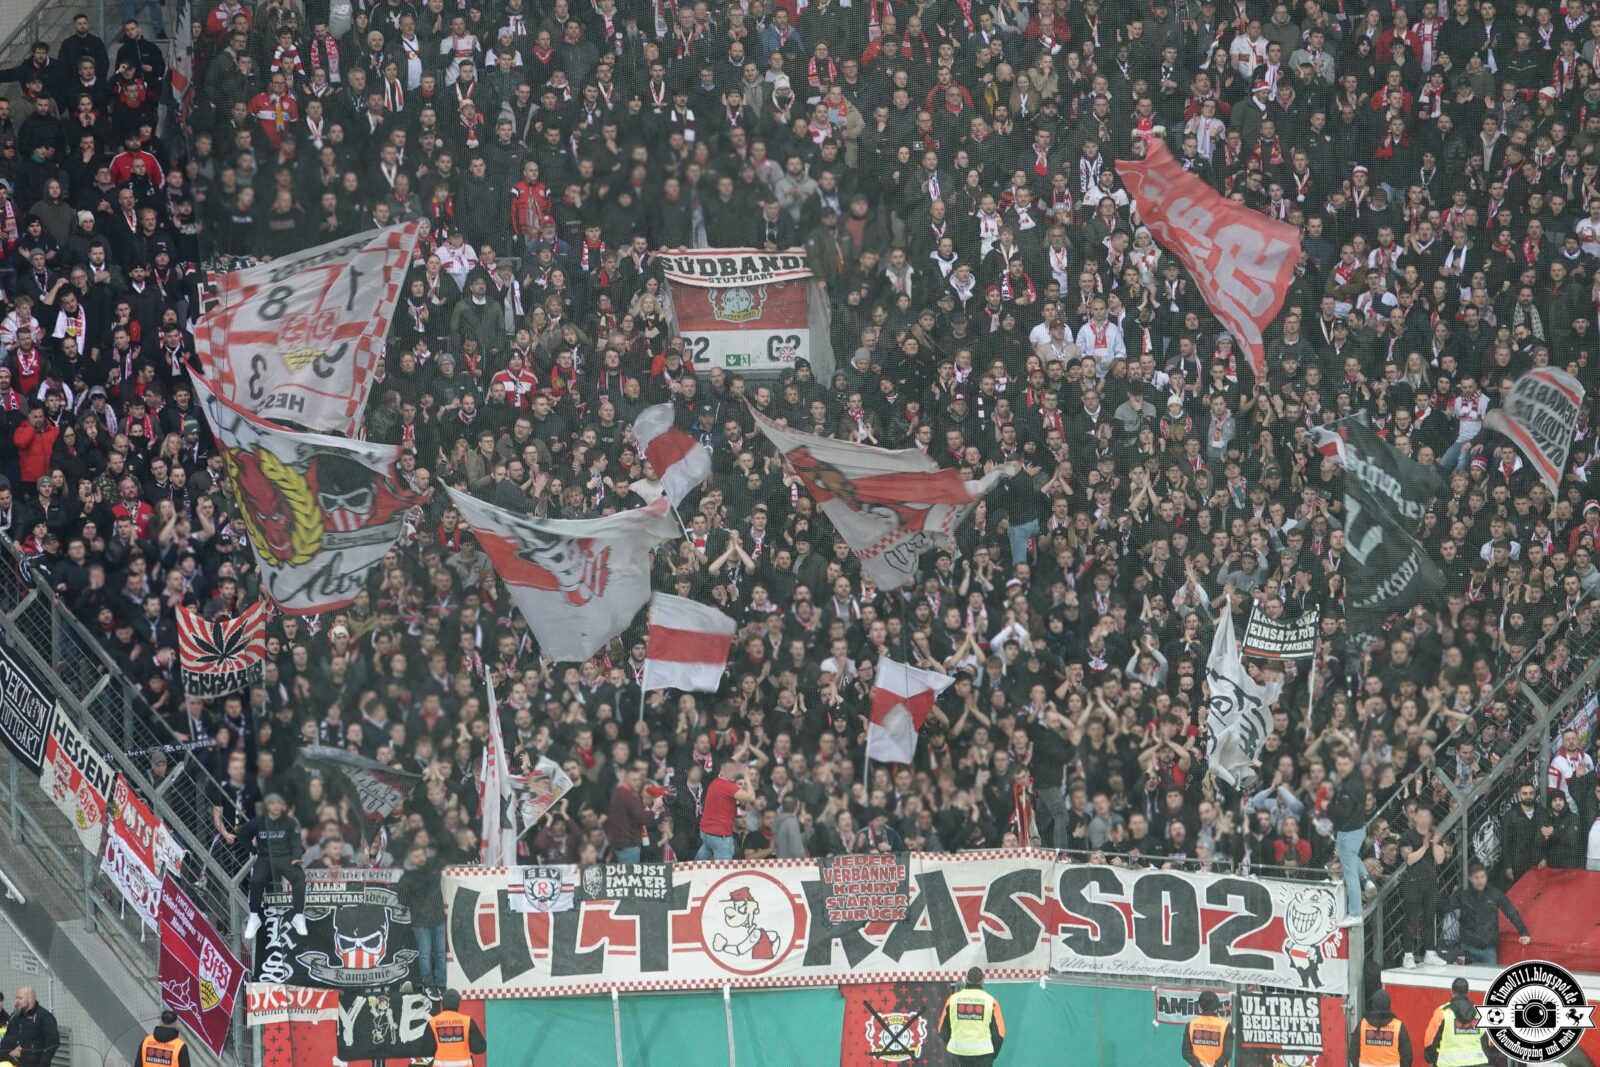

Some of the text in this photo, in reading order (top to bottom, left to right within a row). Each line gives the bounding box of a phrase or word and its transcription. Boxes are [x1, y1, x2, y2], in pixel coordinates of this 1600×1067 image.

[707, 272, 775, 284] STUTTGART
[1249, 622, 1297, 641] EINSATZ
[1246, 637, 1282, 652] UNSERE
[52, 713, 111, 801] HESSEN
[122, 802, 153, 848] MTS
[832, 854, 896, 868] JEDER
[527, 867, 559, 879] SSV
[606, 864, 667, 876] DU BIST
[823, 865, 906, 883] VERBANNTE
[312, 882, 347, 892] ALLEN
[537, 881, 548, 896] R
[606, 875, 667, 888] IMMER
[833, 881, 899, 895] KEHRT
[331, 894, 364, 903] ULTRAS
[606, 888, 668, 899] BEI UNS!
[333, 968, 391, 981] Kompanie
[1058, 957, 1105, 970] Ultras
[1219, 967, 1291, 985] Stuttgart
[1242, 995, 1320, 1018] ULTRAS
[1242, 1014, 1320, 1032] BEDEUTET
[1243, 1029, 1322, 1046] WIDERSTAND
